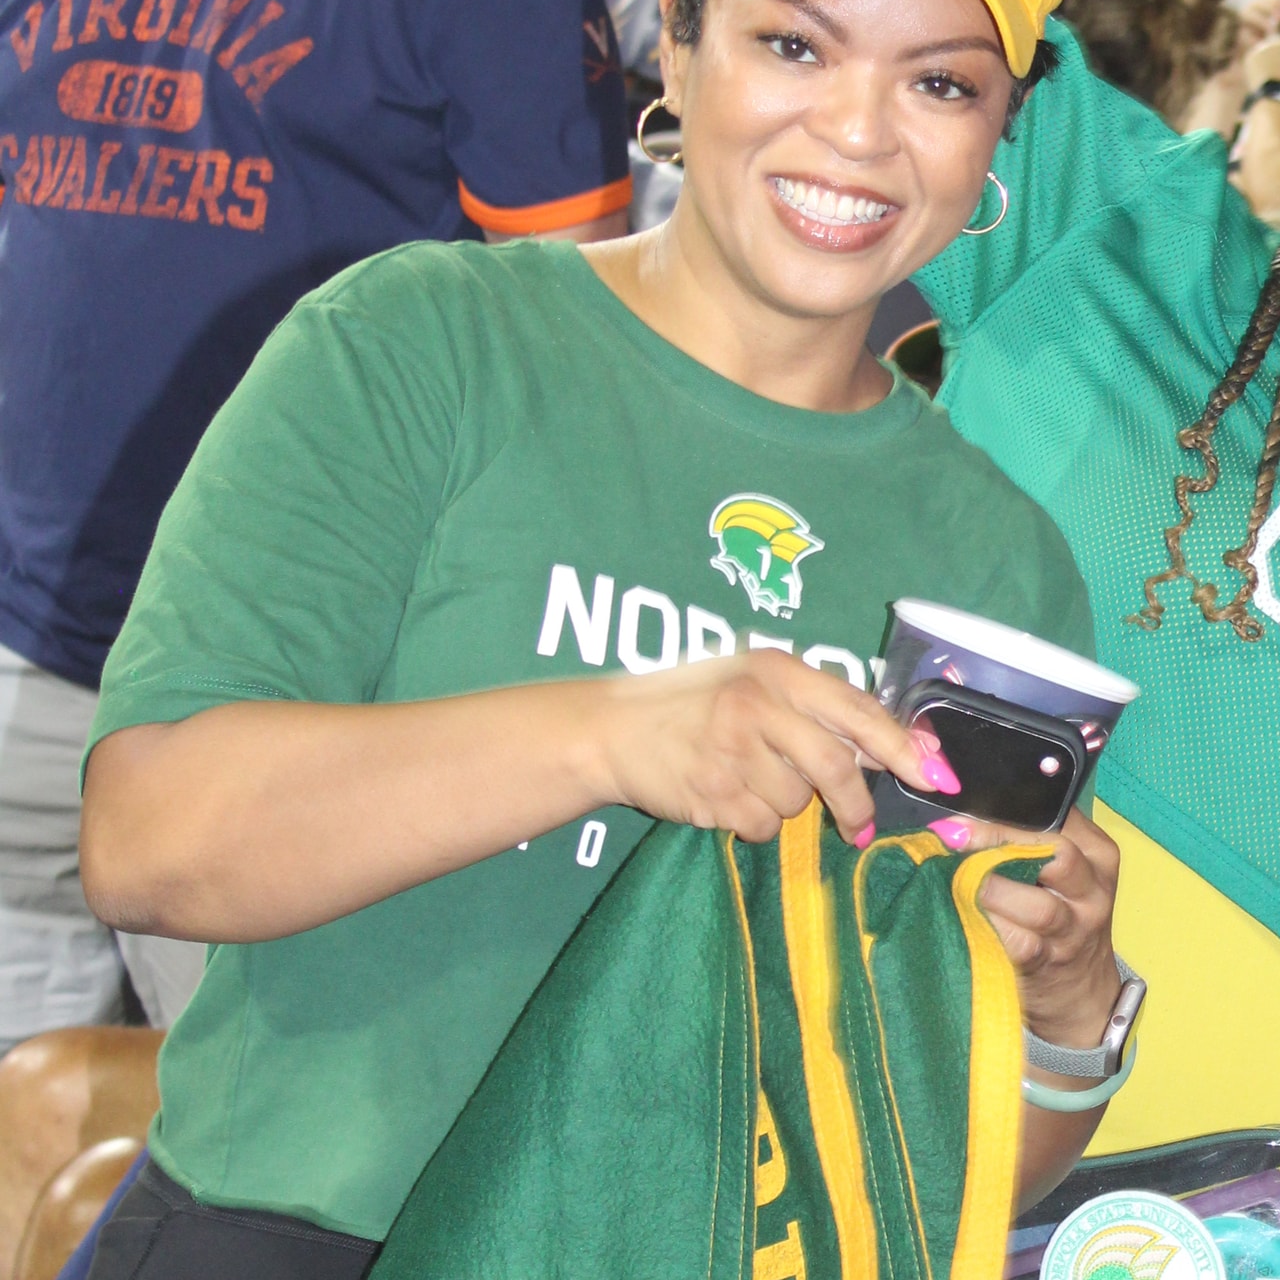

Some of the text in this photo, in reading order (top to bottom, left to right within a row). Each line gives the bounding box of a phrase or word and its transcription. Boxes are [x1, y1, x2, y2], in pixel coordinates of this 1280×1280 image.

[94, 70, 180, 120] 1819
[1085, 1203, 1136, 1233] STATE
[1140, 1203, 1214, 1273] UNIVERSITY
